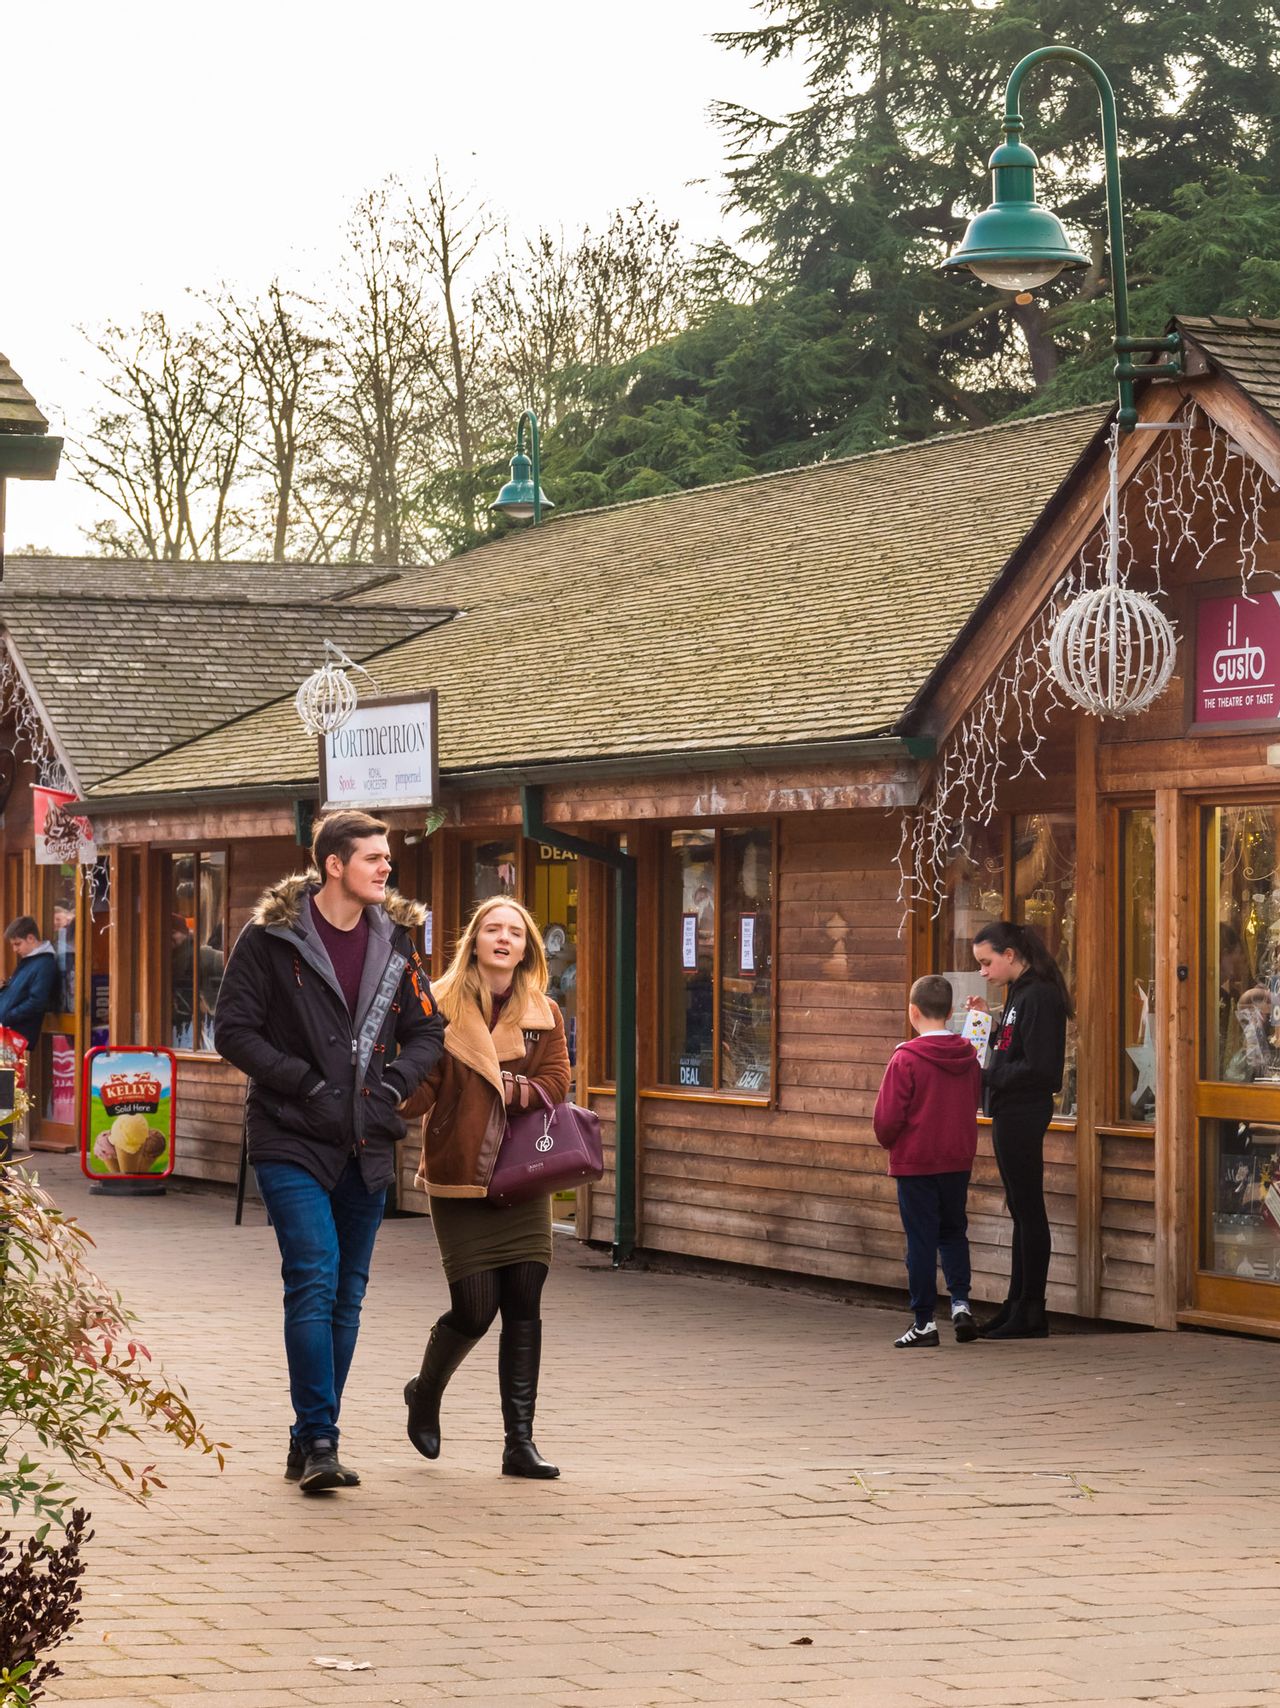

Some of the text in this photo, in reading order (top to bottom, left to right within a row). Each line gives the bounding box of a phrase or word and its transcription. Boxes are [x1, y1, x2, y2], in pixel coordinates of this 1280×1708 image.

[1227, 603, 1237, 647] il
[1204, 693, 1274, 709] THE THEATRE OF TASTE
[680, 1066, 700, 1086] DEAL
[106, 1083, 157, 1099] KELLY'S
[114, 1104, 151, 1114] Sold Here
